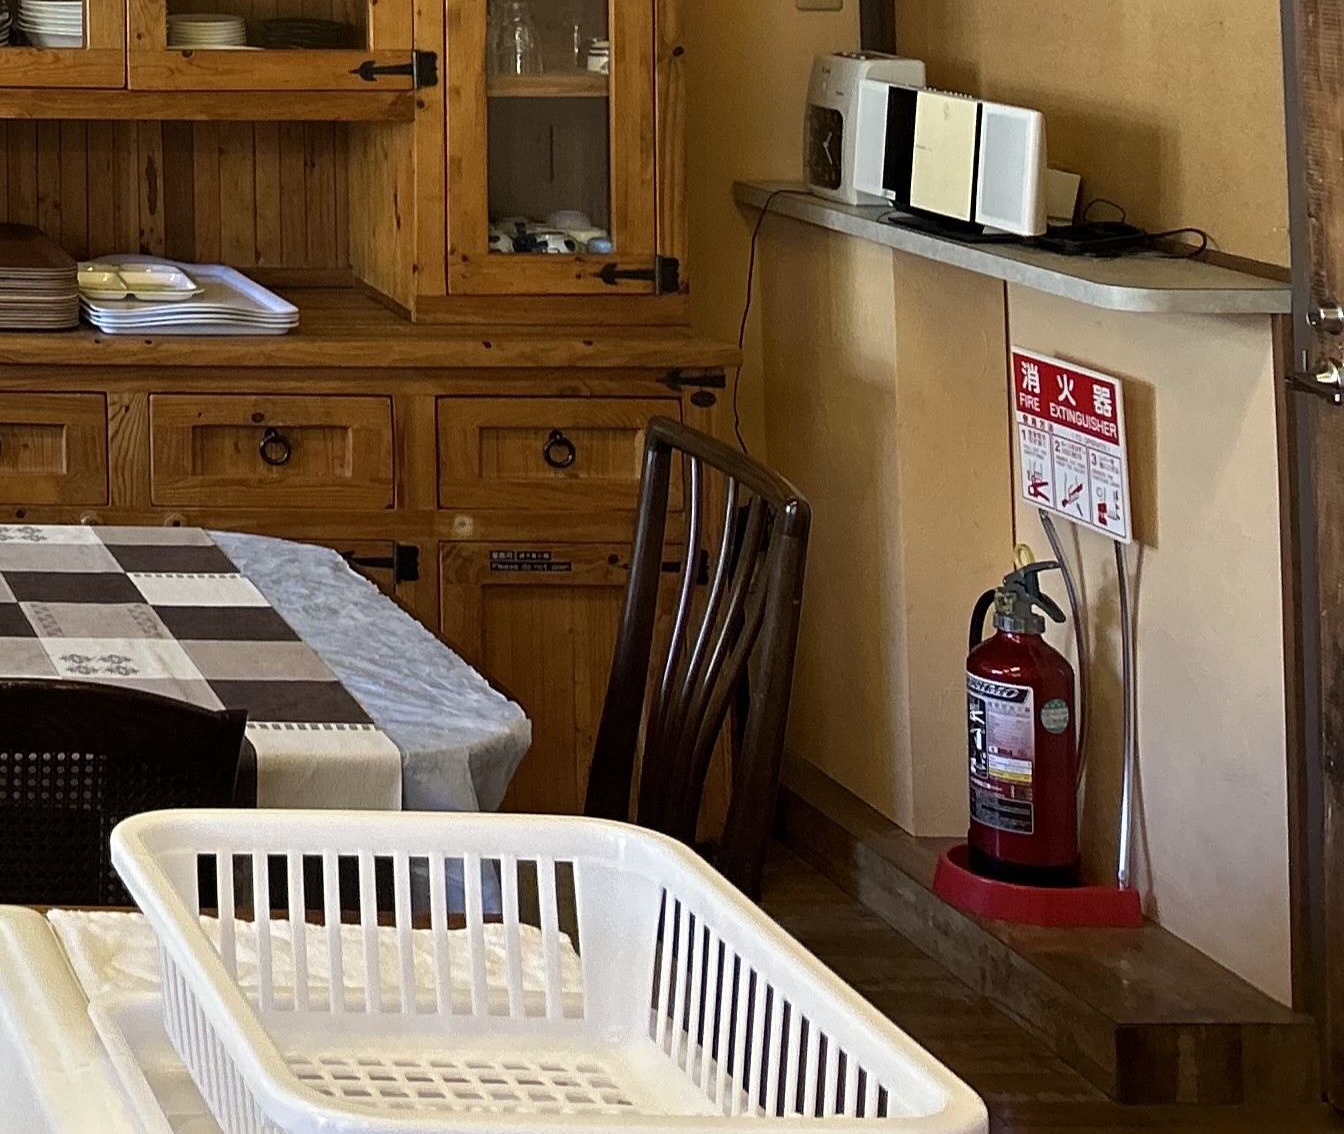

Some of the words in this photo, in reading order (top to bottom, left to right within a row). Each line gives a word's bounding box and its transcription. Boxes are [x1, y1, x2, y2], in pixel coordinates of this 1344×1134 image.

[1020, 360, 1113, 418] 消火器
[1019, 392, 1041, 412] FIRE
[1050, 402, 1118, 439] EXTINGUISHER
[1054, 440, 1061, 452] 2
[1091, 452, 1097, 466] 3
